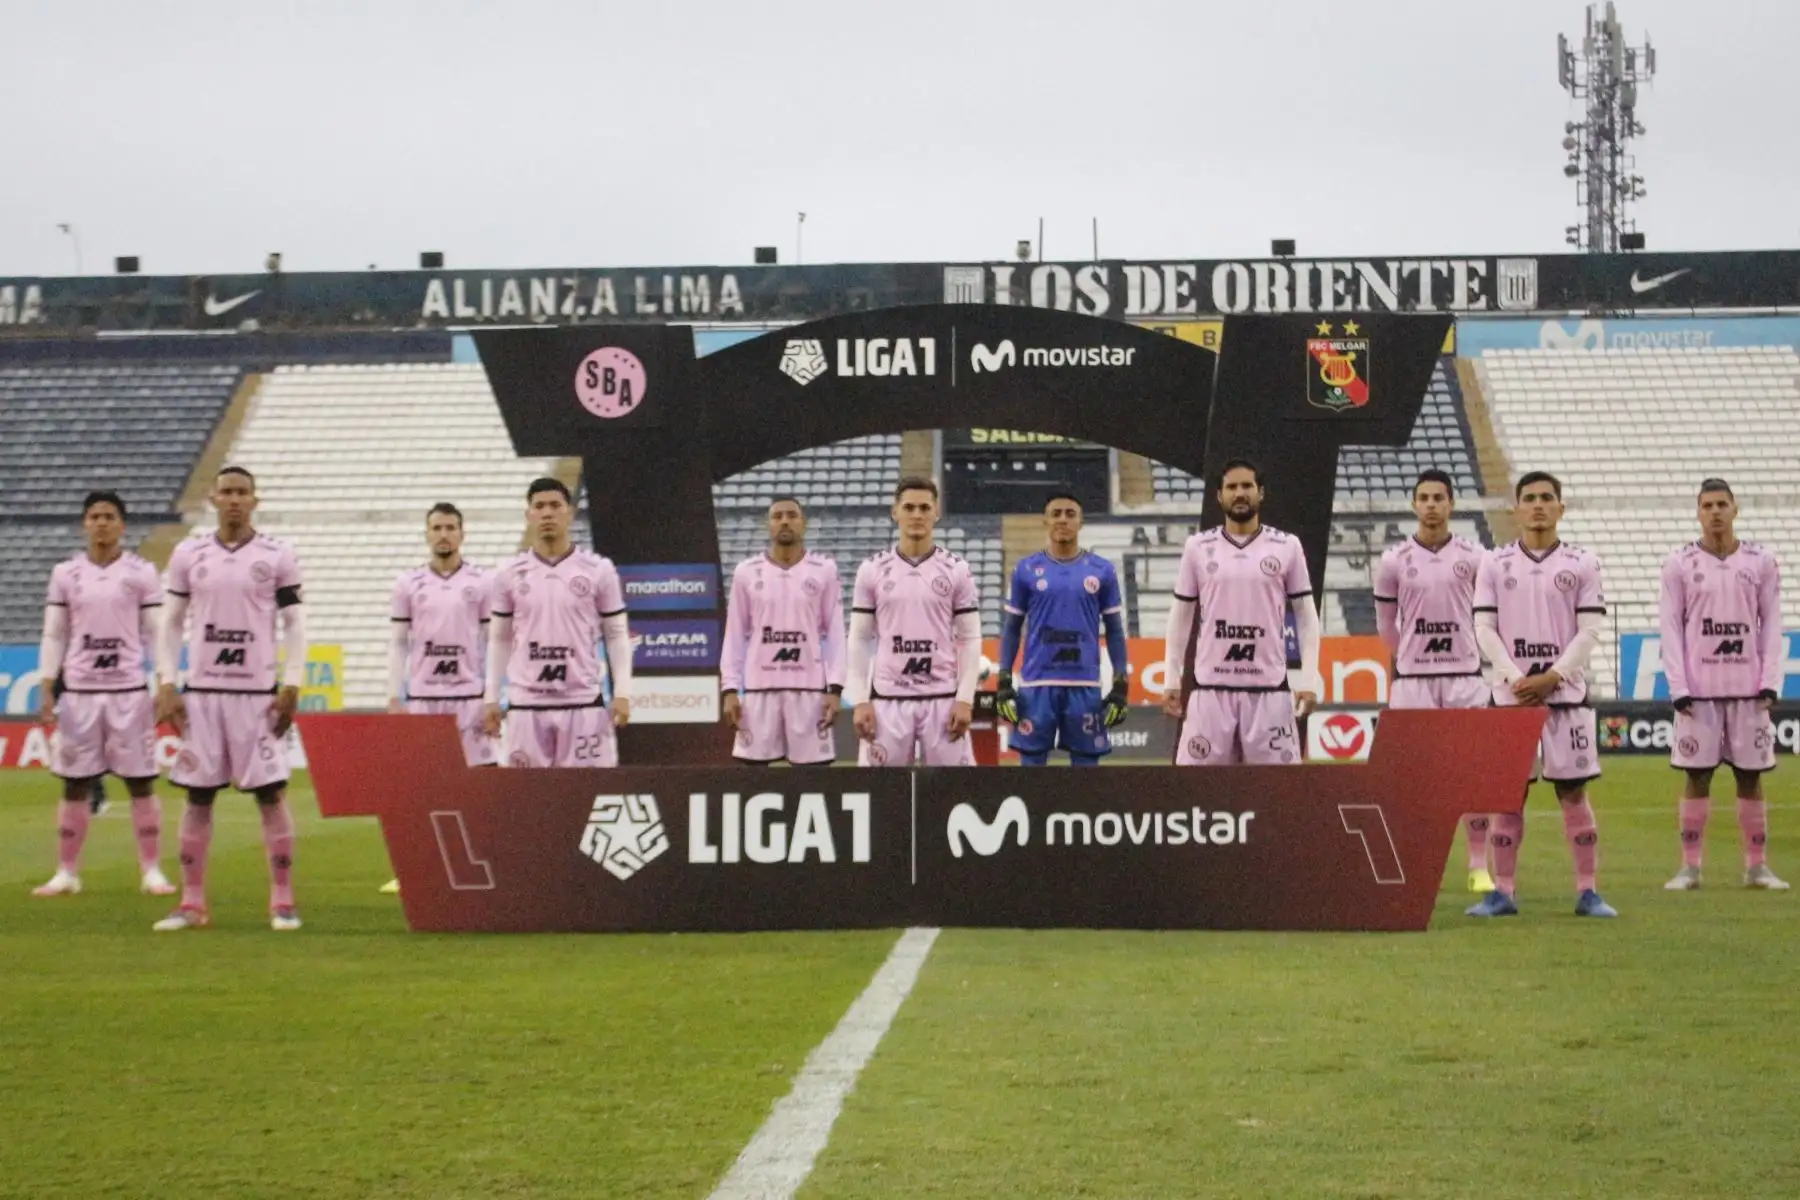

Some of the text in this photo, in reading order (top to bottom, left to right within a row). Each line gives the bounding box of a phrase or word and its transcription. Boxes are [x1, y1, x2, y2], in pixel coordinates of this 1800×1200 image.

[422, 274, 744, 318] ALIANZA LIMA
[991, 258, 1487, 316] LOS DE ORIENTE
[1023, 343, 1136, 368] movistar
[626, 579, 706, 594] marathon
[645, 633, 708, 646] LATAM
[645, 647, 708, 658] AIRLINES
[574, 733, 601, 760] 22
[1046, 806, 1256, 845] movistar
